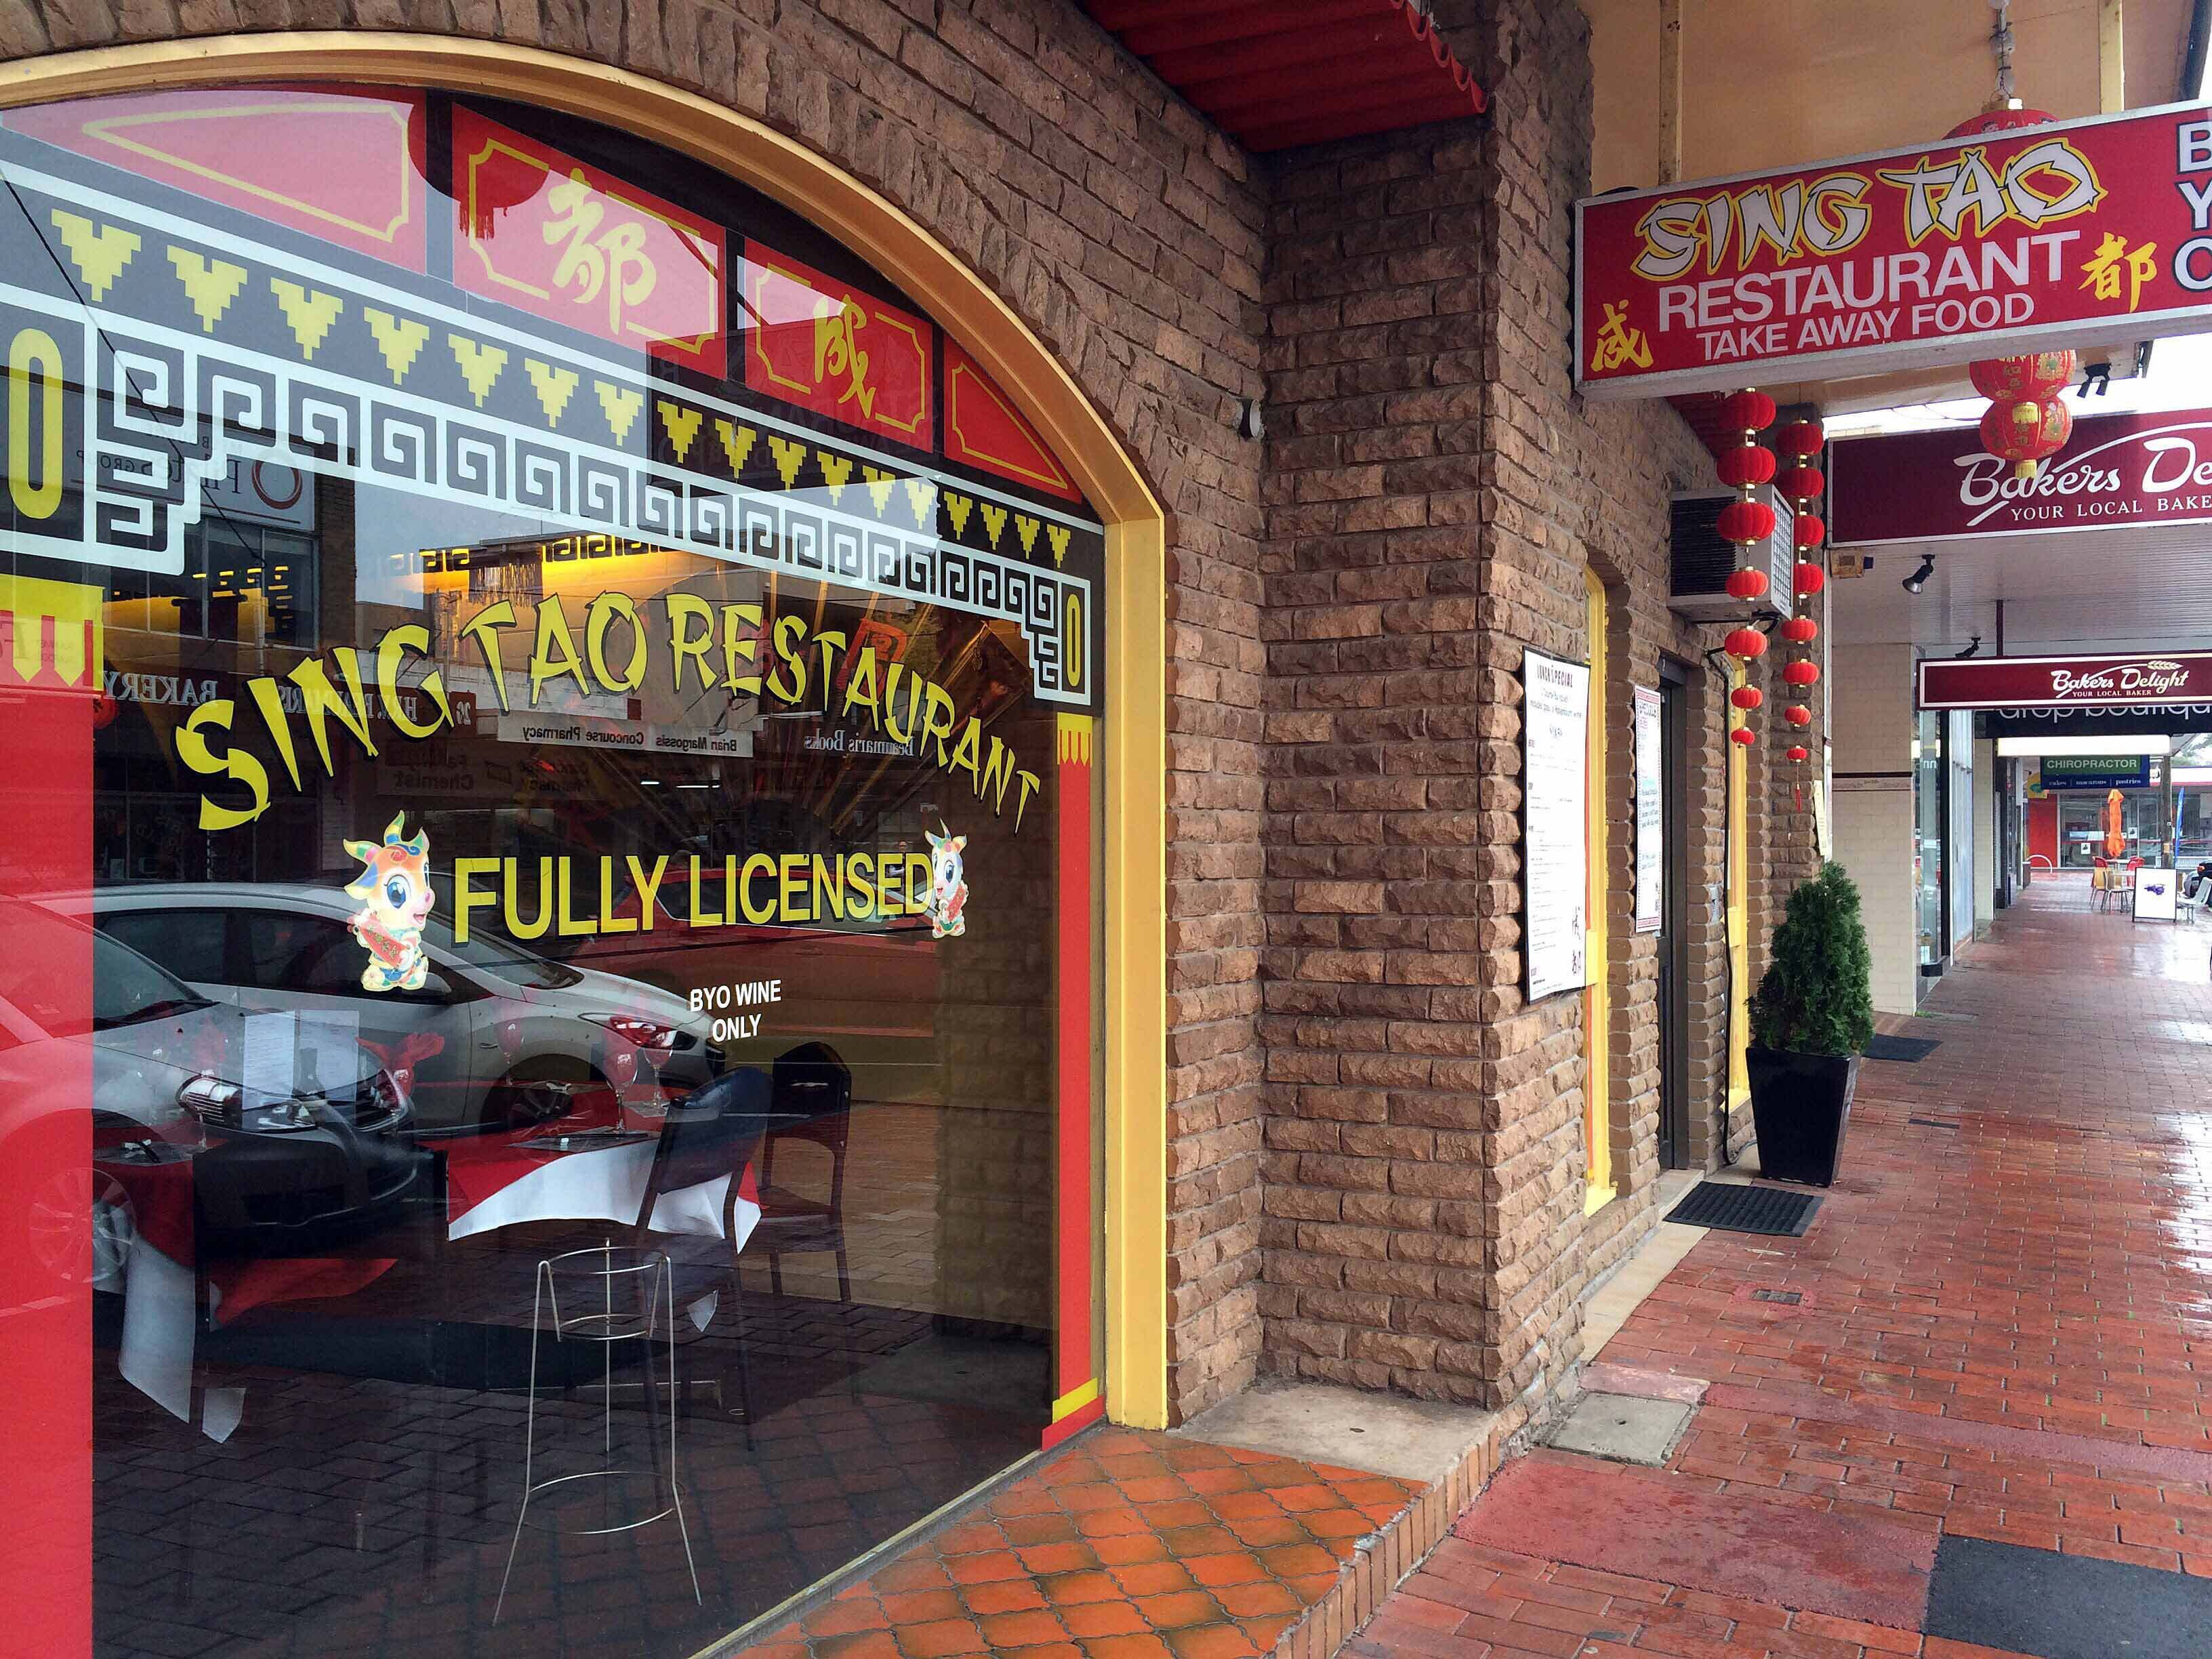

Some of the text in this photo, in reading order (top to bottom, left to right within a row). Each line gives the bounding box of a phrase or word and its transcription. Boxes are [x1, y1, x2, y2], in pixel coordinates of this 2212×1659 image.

[1631, 138, 2108, 281] SING TAO
[1659, 230, 2080, 332] RESTAURANT
[2078, 232, 2157, 313] 都
[1696, 292, 2034, 361] TAKE AWAY FOOD
[1953, 452, 2121, 510] Bakers
[2011, 505, 2065, 521] YOUR
[2077, 499, 2143, 517] LOCAL
[176, 590, 1040, 834] SING TAO RESTAURANT
[2050, 668, 2190, 694] Bakers Delight
[2047, 759, 2137, 769] CHIROPRACTOR
[455, 855, 669, 944] FULLY
[690, 851, 933, 926] LICENSED
[690, 979, 781, 1012] BYO WINE
[712, 1013, 762, 1042] ONLY
